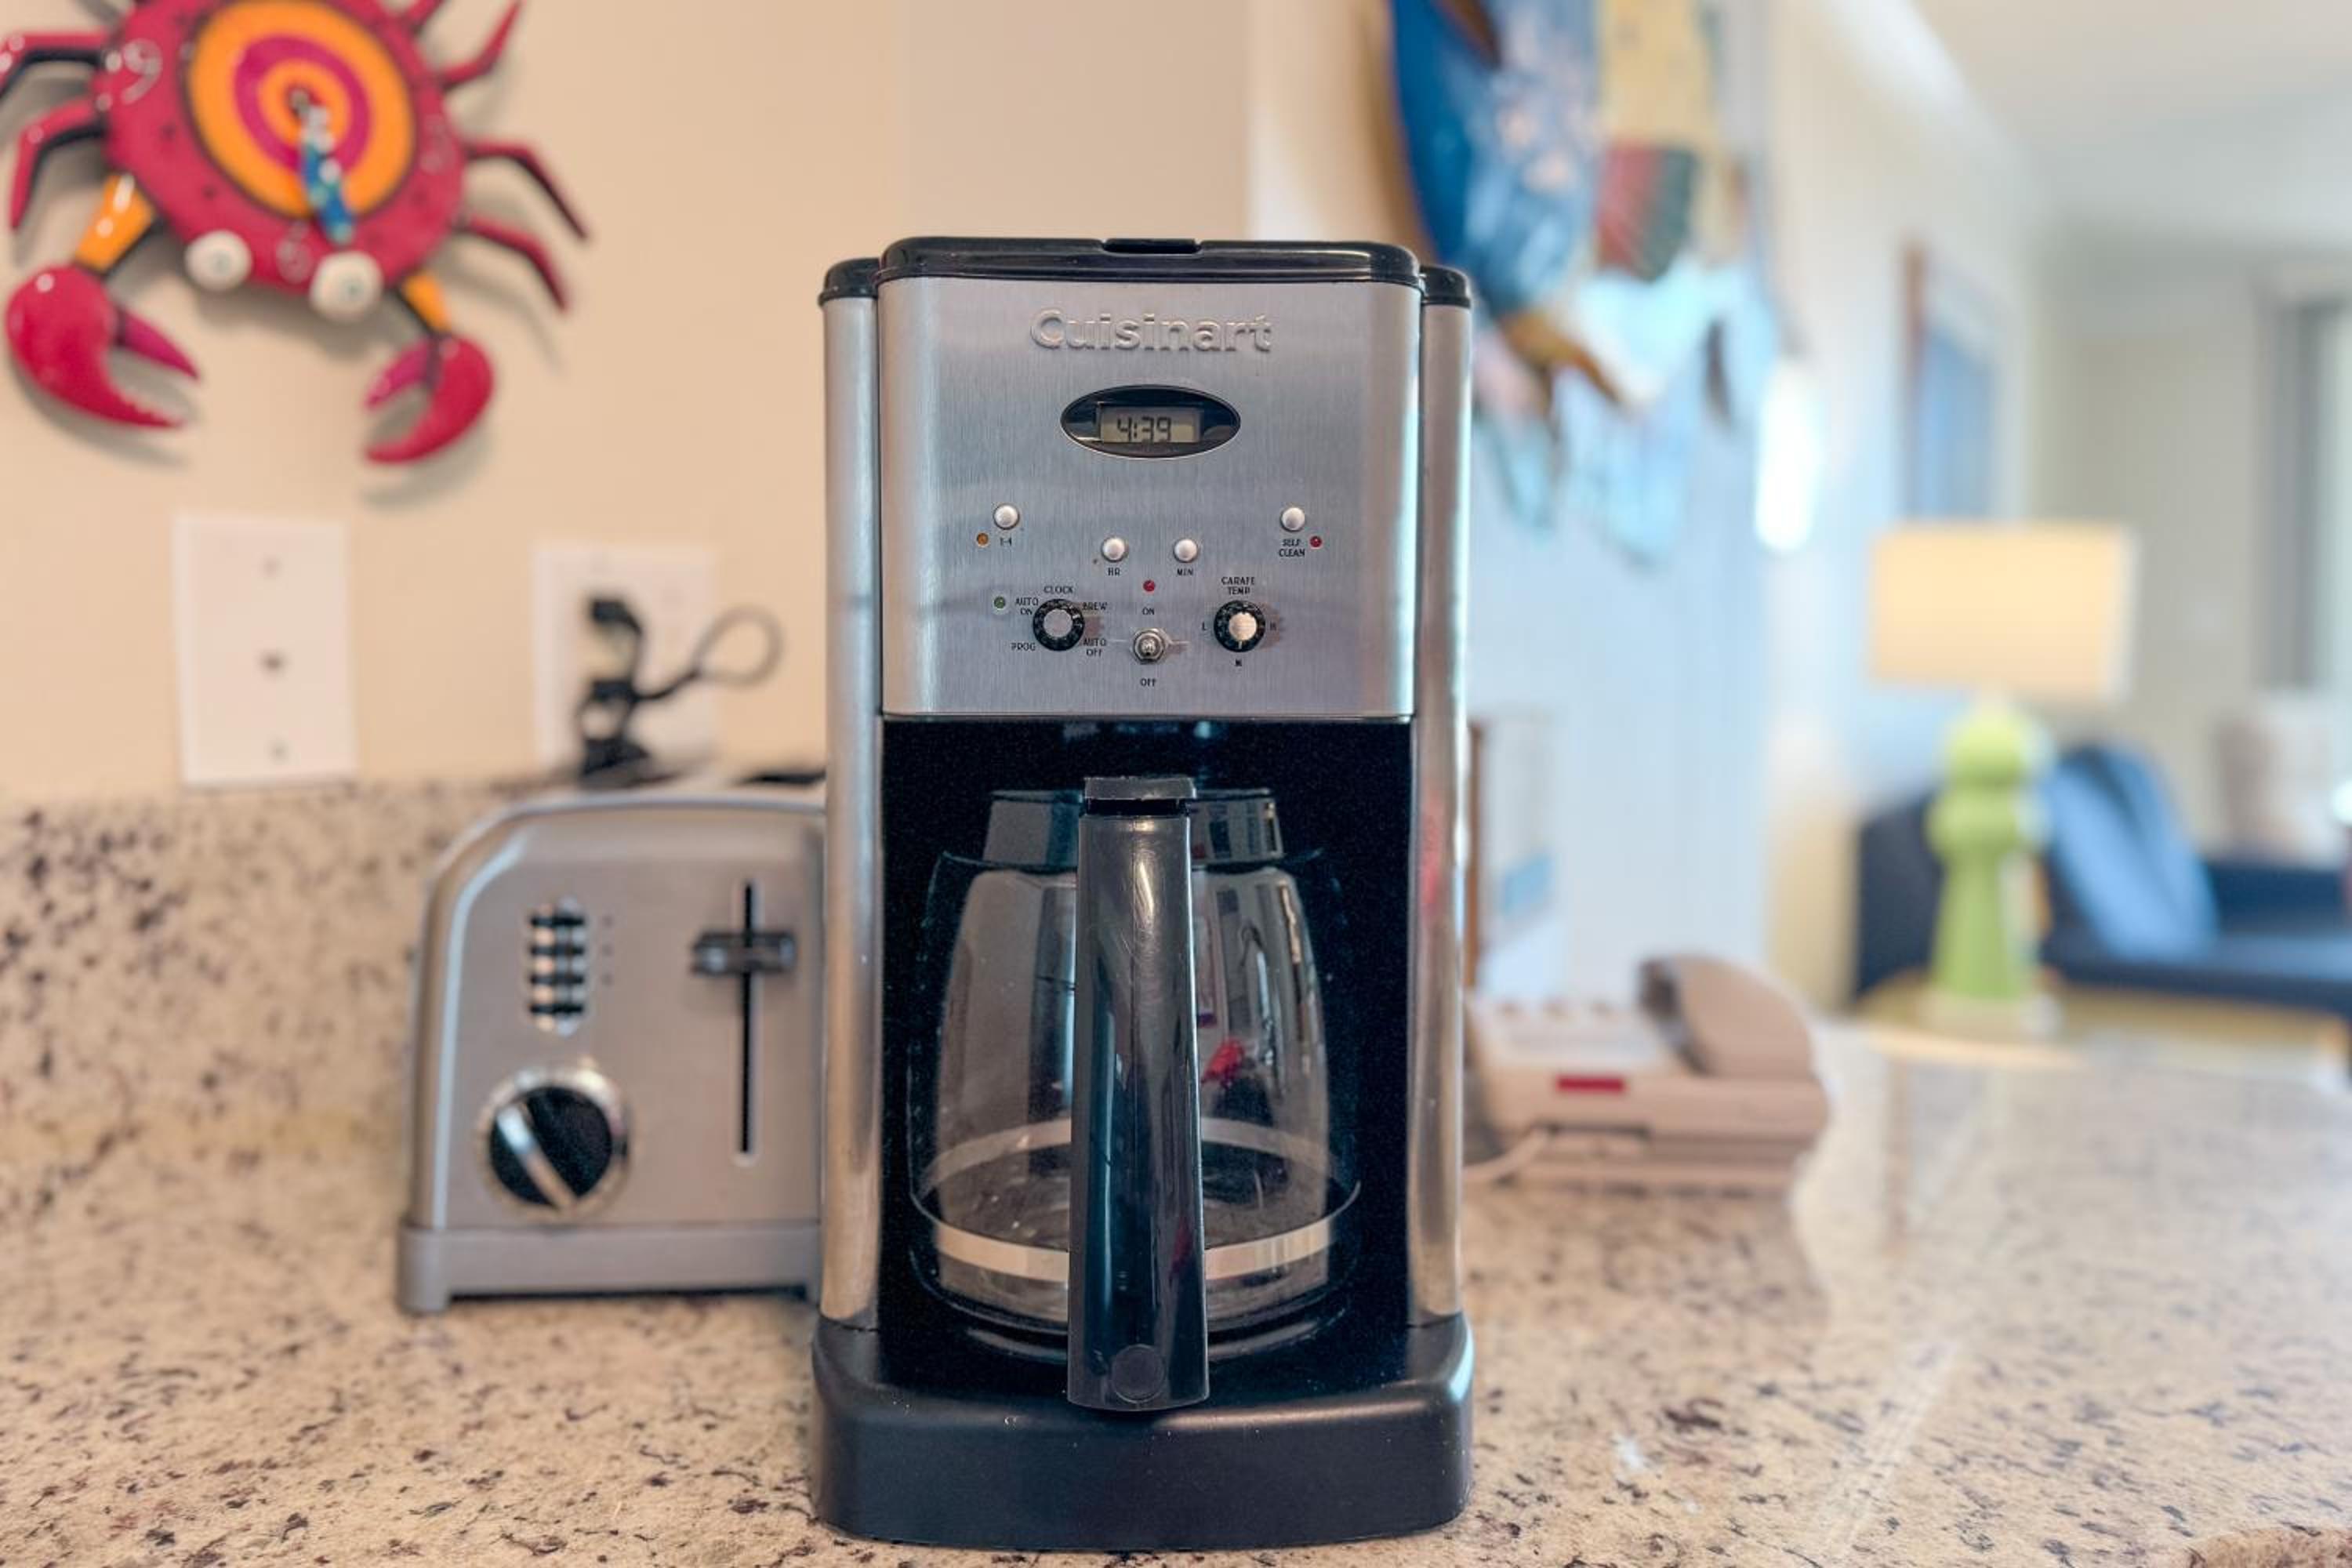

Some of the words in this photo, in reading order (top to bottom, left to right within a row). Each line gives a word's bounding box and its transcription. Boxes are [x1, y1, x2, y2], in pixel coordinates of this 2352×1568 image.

[122, 38, 162, 104] 9
[1029, 309, 1272, 353] Cuisinart
[1117, 416, 1172, 442] 4:39
[1279, 548, 1305, 557] CLEAN
[1221, 576, 1255, 585] CARAFE
[1016, 597, 1039, 606] AUTO
[1082, 601, 1108, 611] BREW
[1083, 637, 1106, 646] AUTO
[1011, 642, 1036, 652] PROG
[1086, 648, 1102, 657] OFF
[1140, 678, 1156, 687] OFF
